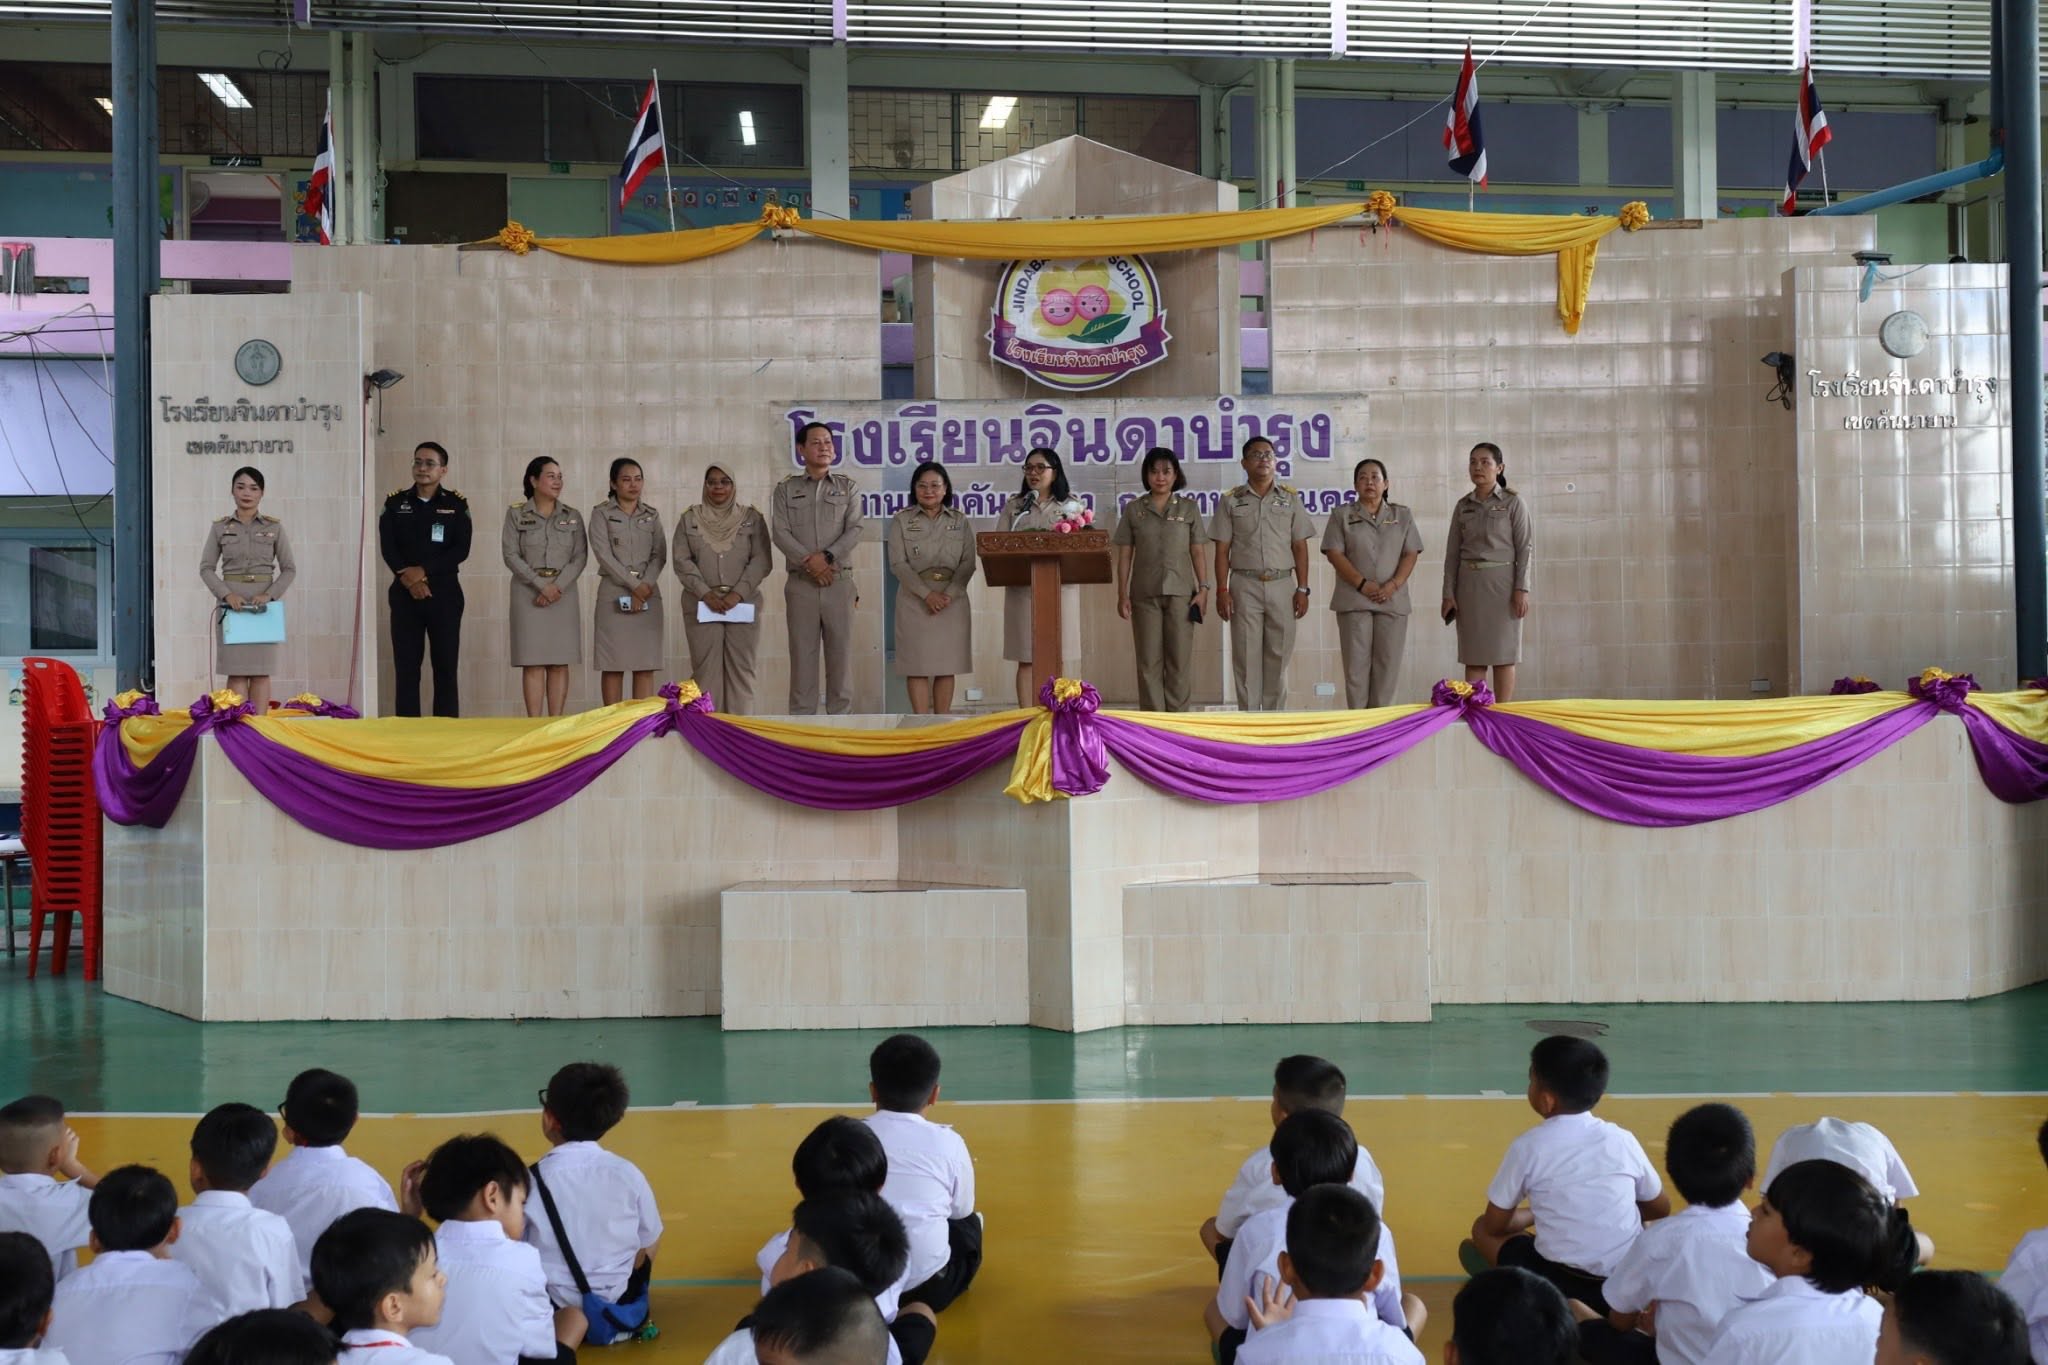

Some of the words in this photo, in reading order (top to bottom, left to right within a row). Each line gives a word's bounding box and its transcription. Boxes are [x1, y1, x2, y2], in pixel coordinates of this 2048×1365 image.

[1108, 256, 1145, 311] SCHOOL
[1004, 337, 1148, 368] โรงเรียนจินดาบำรุง
[1808, 368, 1997, 404] โรงเรียนจินดาบำรุง
[158, 396, 343, 431] โรงเรียนจินดาบำรุง
[1843, 408, 1958, 430] เขตคันนายาว
